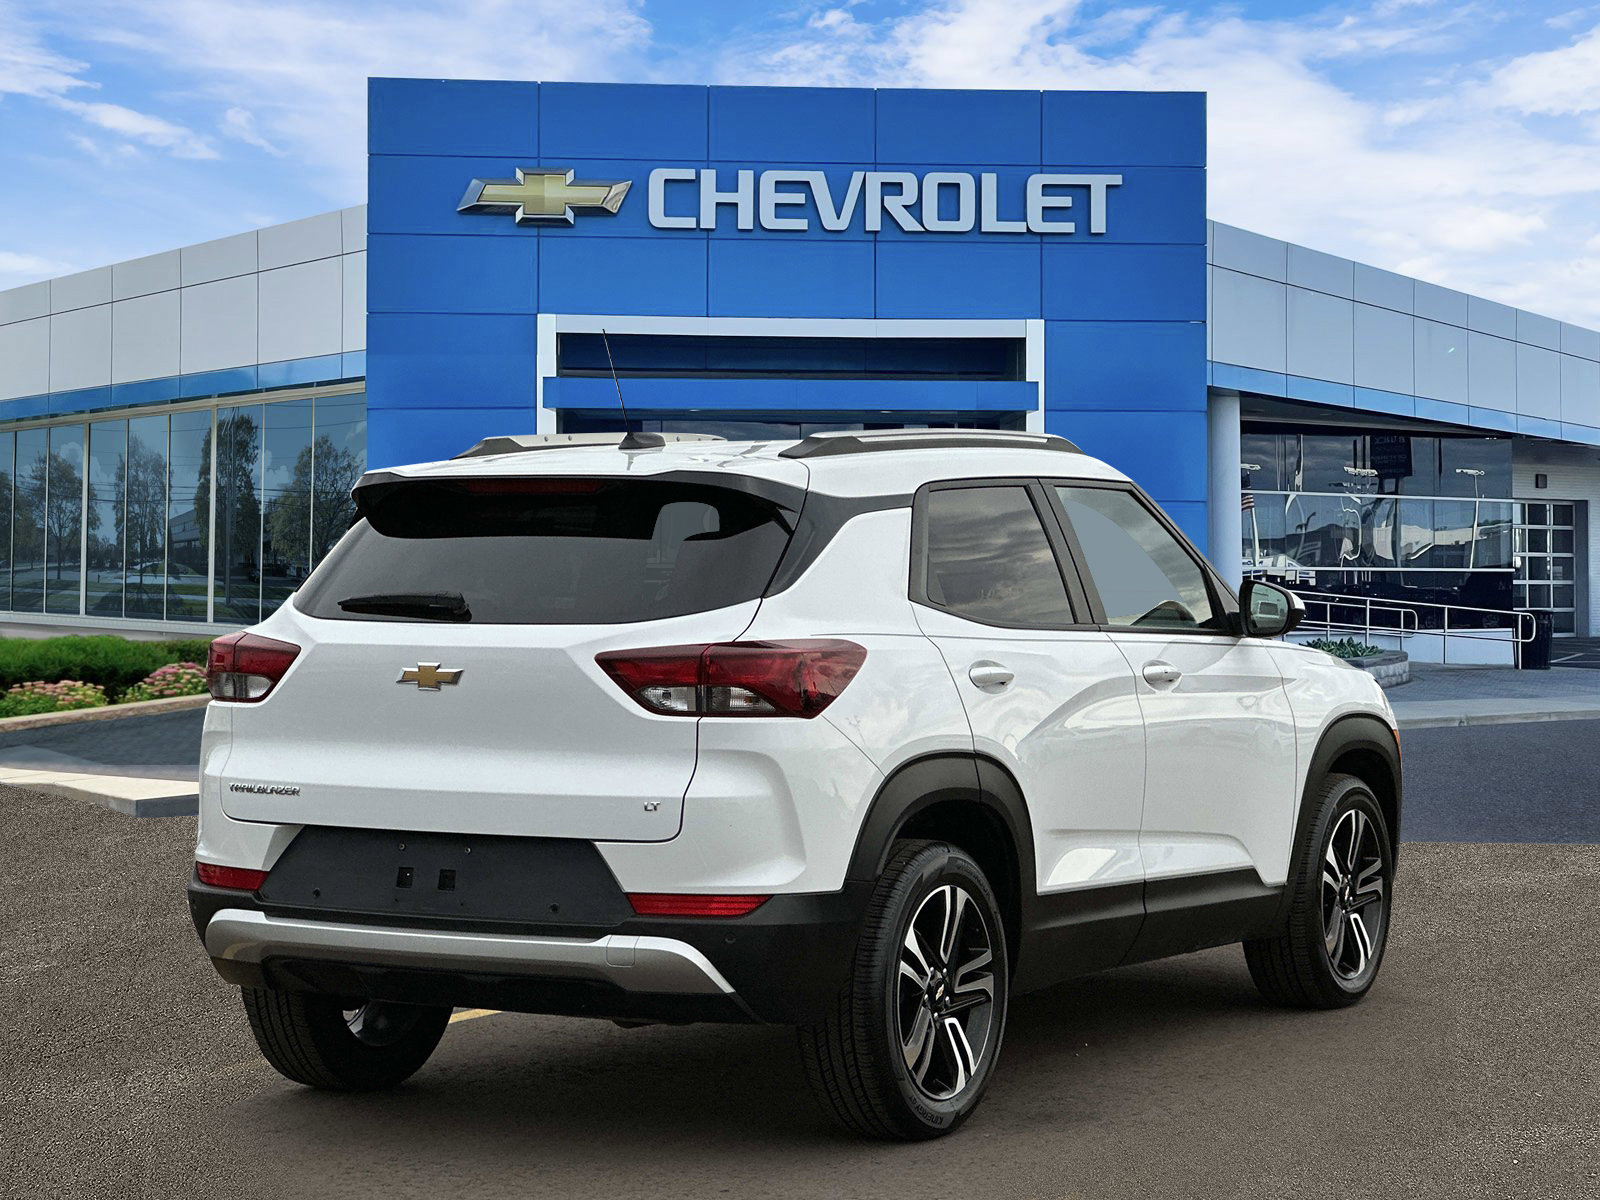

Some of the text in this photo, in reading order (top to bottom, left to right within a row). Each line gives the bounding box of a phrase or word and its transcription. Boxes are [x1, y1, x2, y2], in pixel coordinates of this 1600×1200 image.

[648, 168, 1123, 234] CHEVROLET
[229, 782, 301, 797] TRAILBLAZER
[643, 801, 661, 812] LT
[914, 1103, 944, 1126] KINERGY
